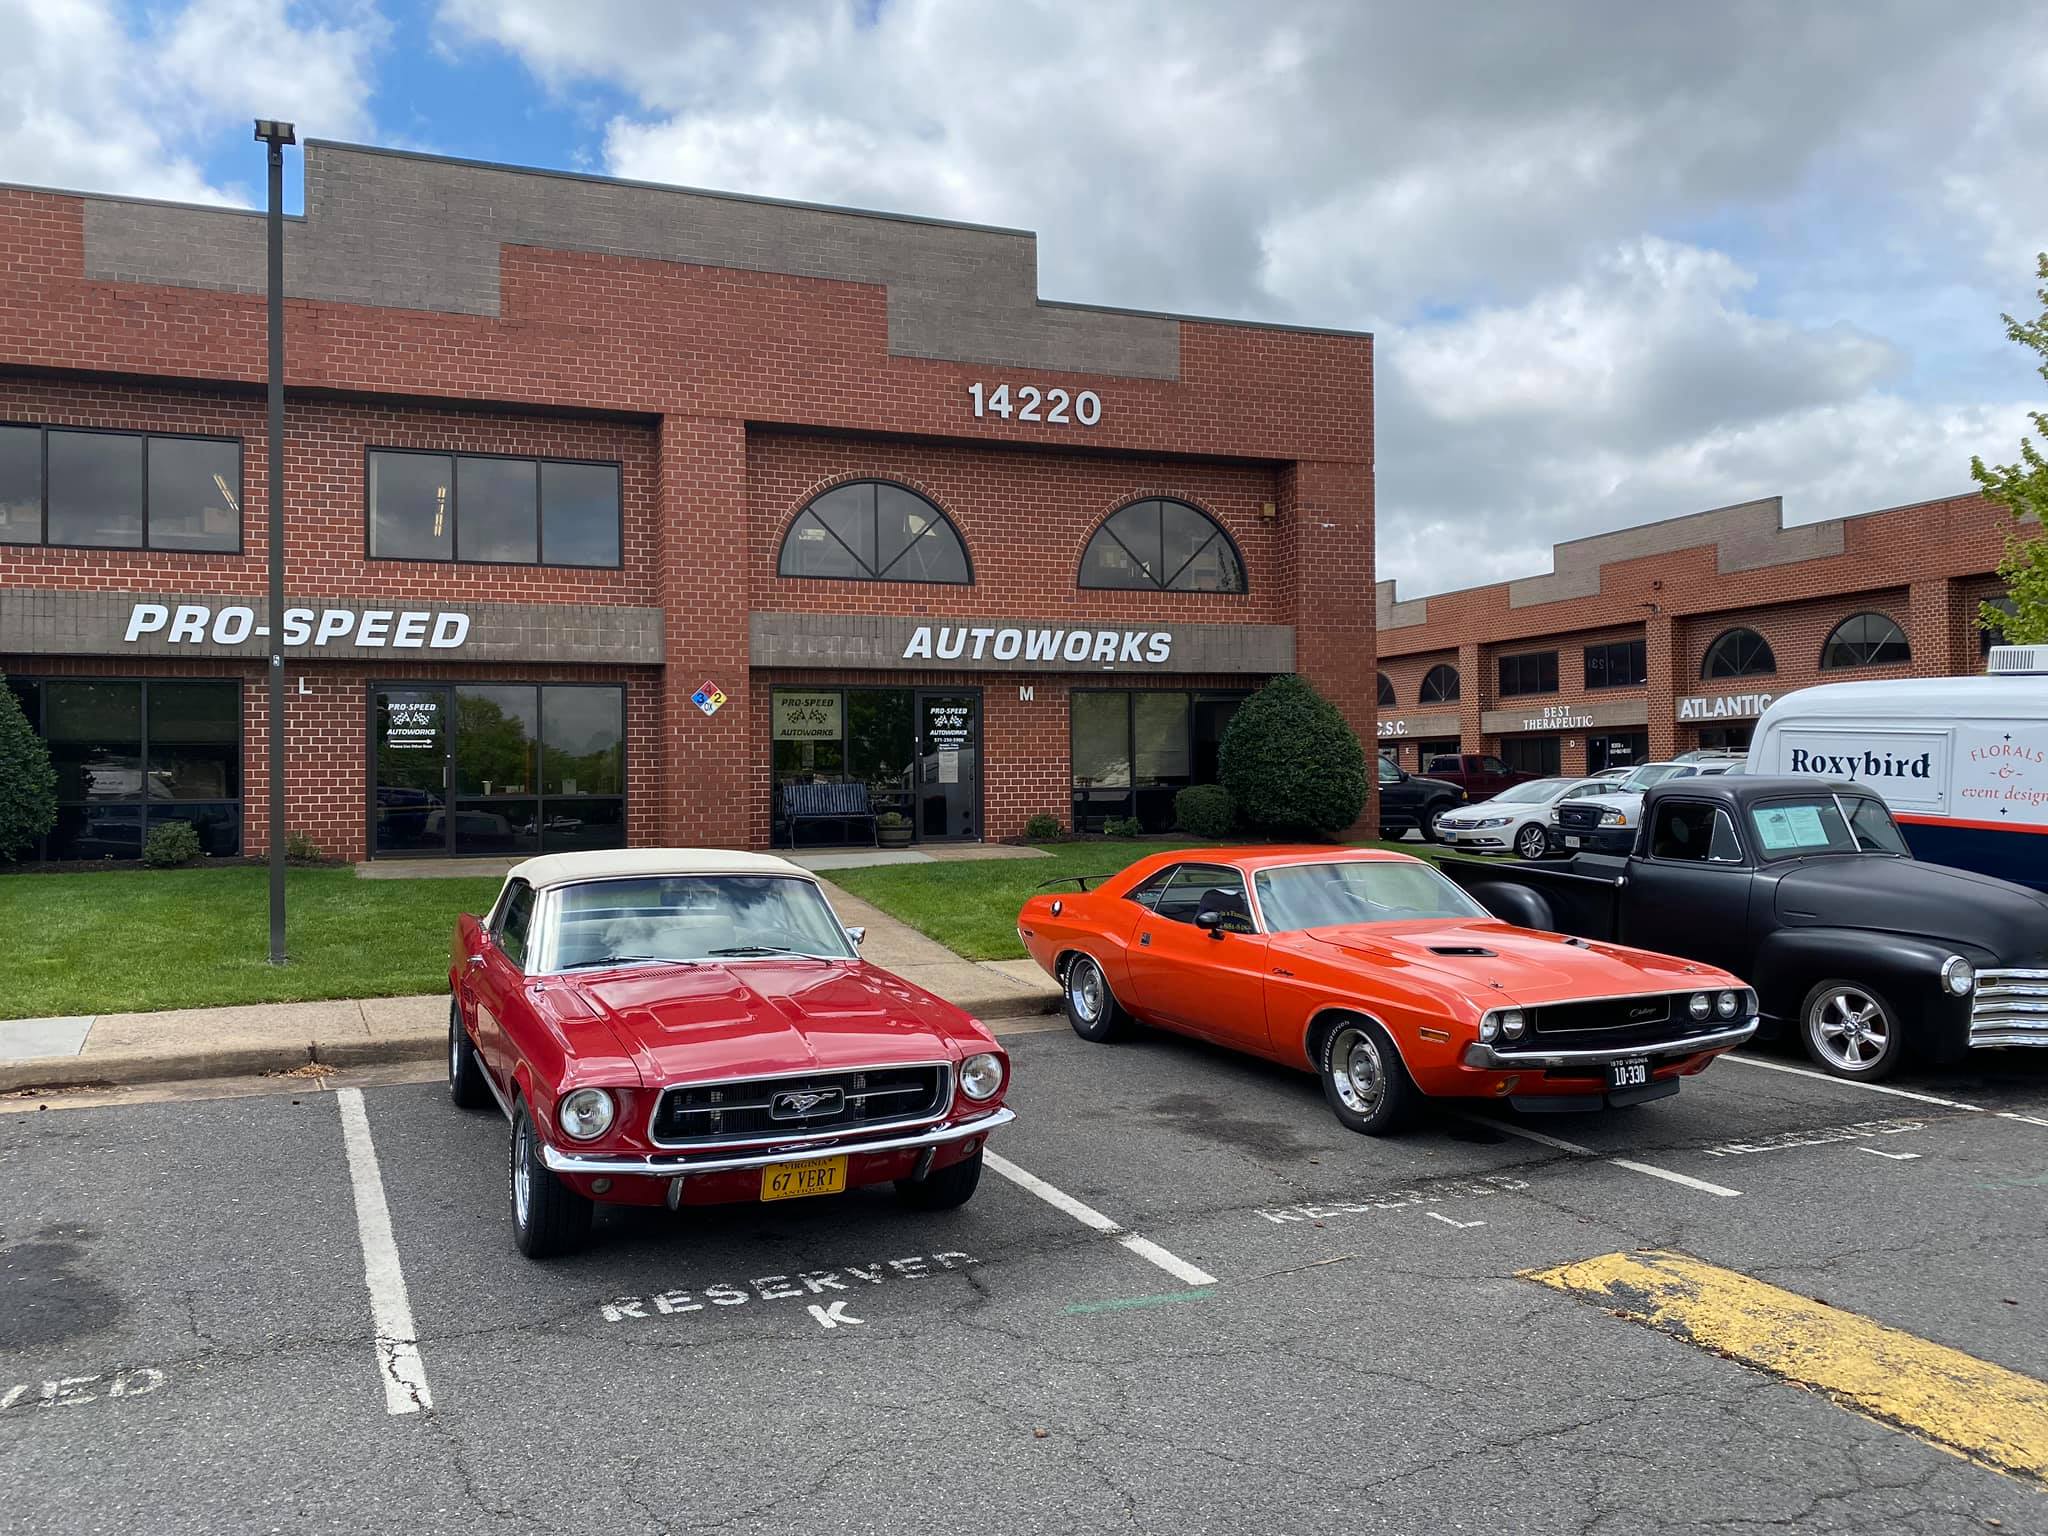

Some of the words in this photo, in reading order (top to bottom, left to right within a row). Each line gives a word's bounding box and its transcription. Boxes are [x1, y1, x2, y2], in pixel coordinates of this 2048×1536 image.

[968, 382, 1102, 426] 14220
[124, 603, 471, 649] PRO-SPEED
[902, 626, 1173, 663] AUTOWORKS
[299, 676, 313, 694] L
[703, 684, 712, 696] 4
[697, 692, 705, 704] 3
[714, 692, 722, 703] 2
[1020, 686, 1034, 701] M
[387, 703, 437, 711] PRO-SPEED
[781, 698, 834, 707] PRO-SPEED
[1680, 694, 1773, 719] ATLANTIC
[930, 707, 968, 715] PRO-SPEED
[1543, 706, 1571, 718] BEST
[1523, 715, 1594, 730] THERAPEUTIC
[1570, 739, 1576, 748] D
[1970, 744, 2045, 763] FLORALS
[1791, 749, 1931, 782] Roxybird
[1962, 787, 2000, 799] event
[1857, 1146, 1923, 1160] L
[784, 1159, 828, 1170] VIRGINIA
[772, 1172, 793, 1192] 67
[798, 1167, 837, 1188] VERT
[1425, 1211, 1488, 1228] L
[807, 1301, 864, 1328] K
